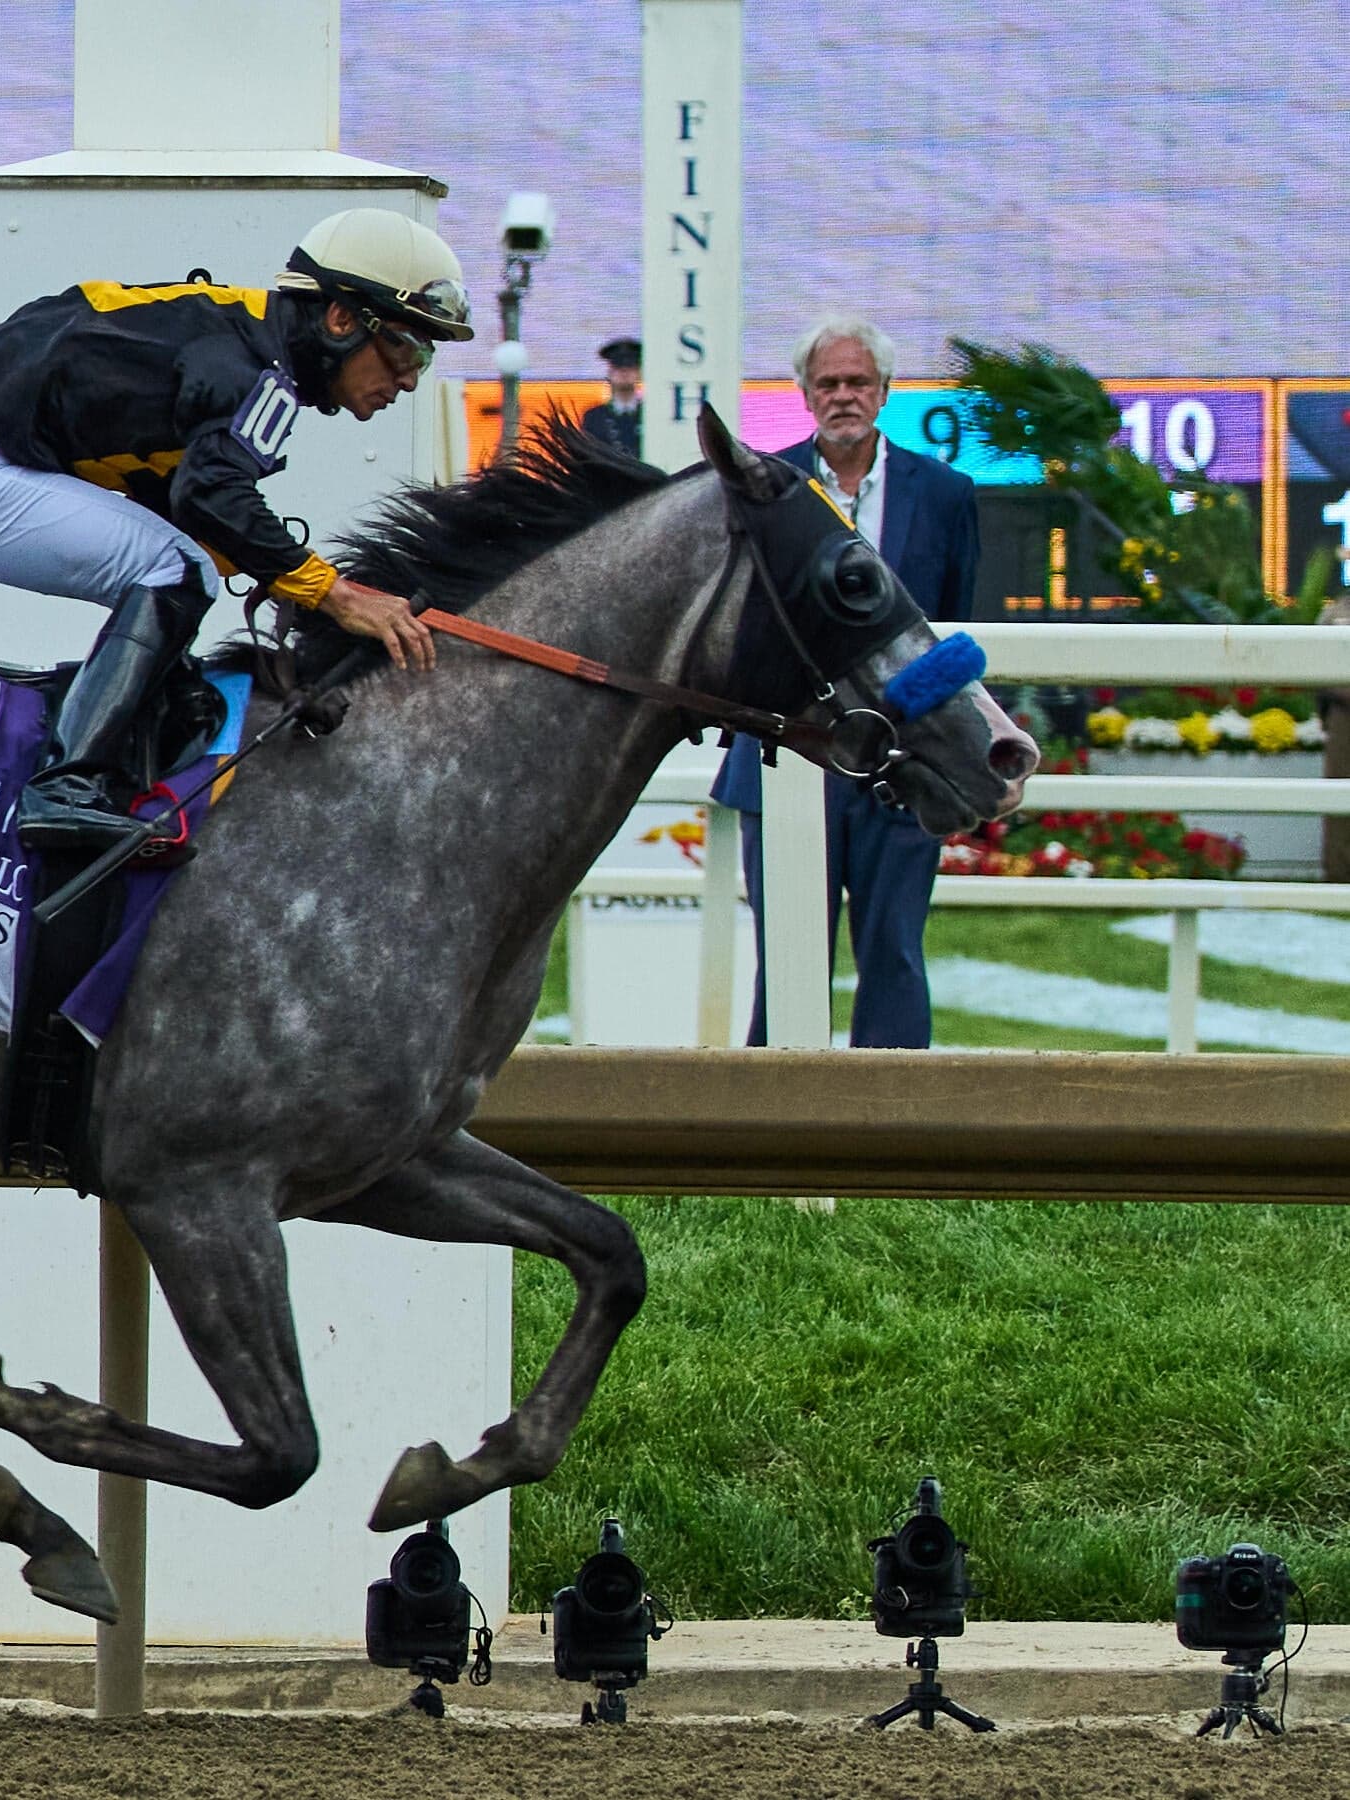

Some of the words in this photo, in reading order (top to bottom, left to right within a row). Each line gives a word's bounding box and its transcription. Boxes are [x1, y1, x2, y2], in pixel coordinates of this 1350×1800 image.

[668, 101, 713, 420] FINISH
[239, 377, 297, 456] 10
[921, 405, 960, 465] 9
[1118, 400, 1216, 472] 10
